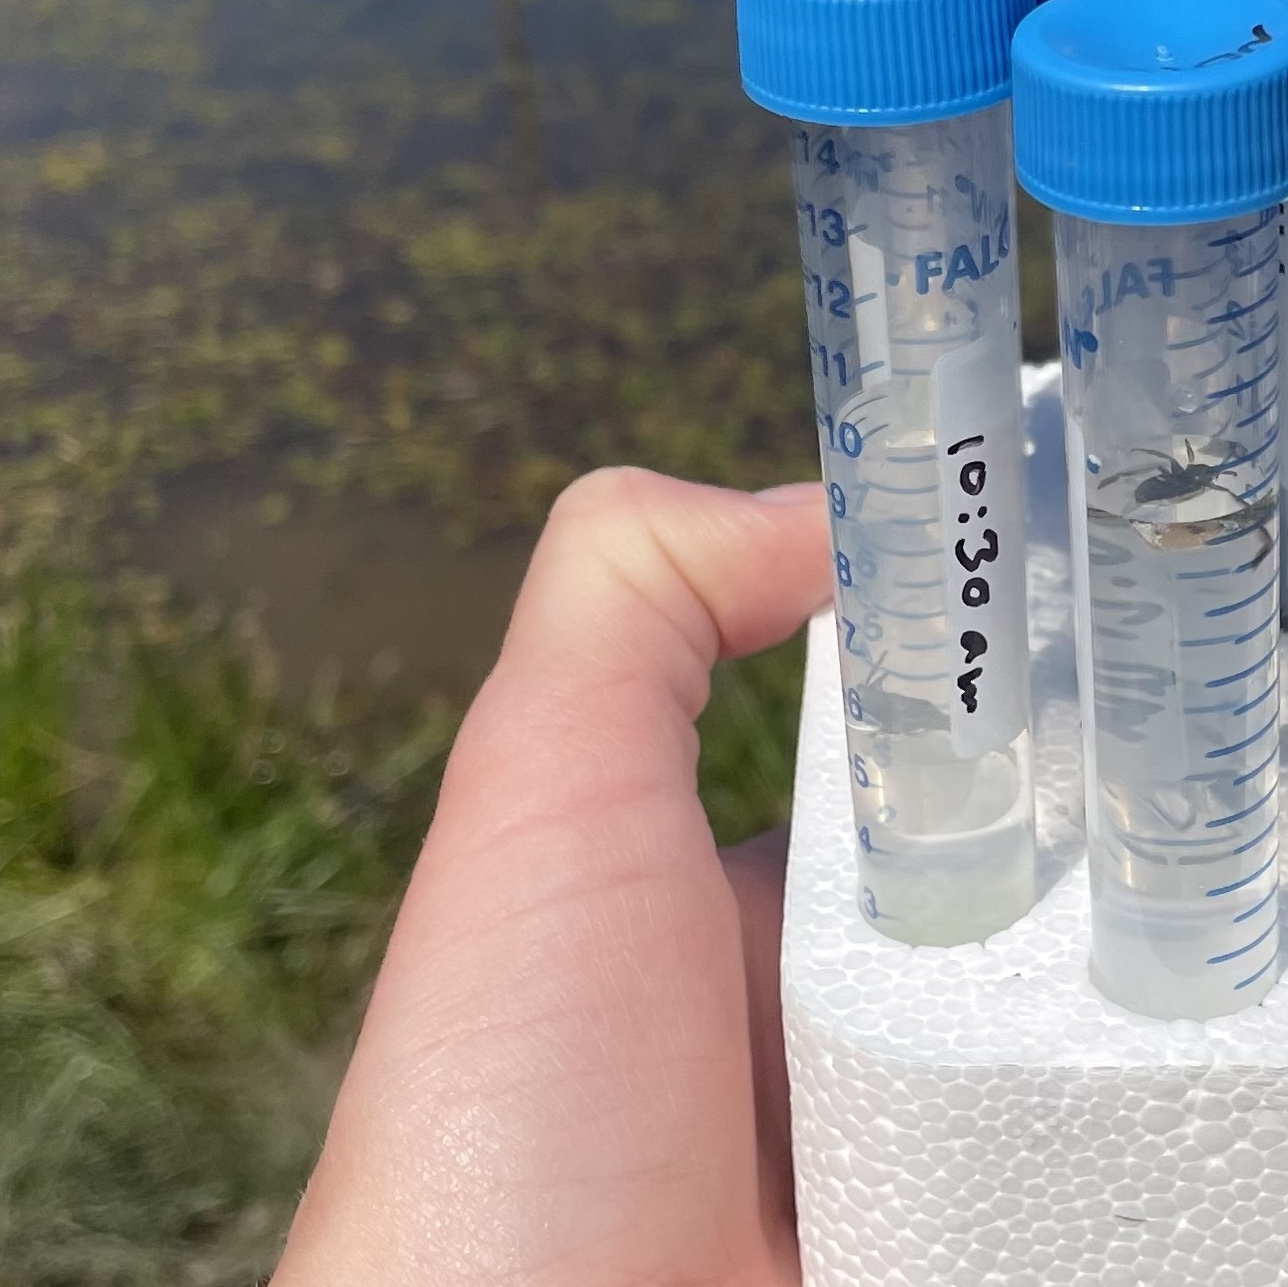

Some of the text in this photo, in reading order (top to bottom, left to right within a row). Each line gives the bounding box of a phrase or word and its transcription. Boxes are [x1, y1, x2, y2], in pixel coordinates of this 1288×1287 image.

[803, 203, 846, 247] 13
[807, 274, 852, 319] 12
[814, 345, 848, 387] 11
[830, 482, 847, 519] 9
[946, 433, 999, 608] 10:30
[836, 550, 853, 588] 8
[841, 615, 858, 653] 7
[848, 687, 864, 722] 6
[854, 753, 870, 788] 5
